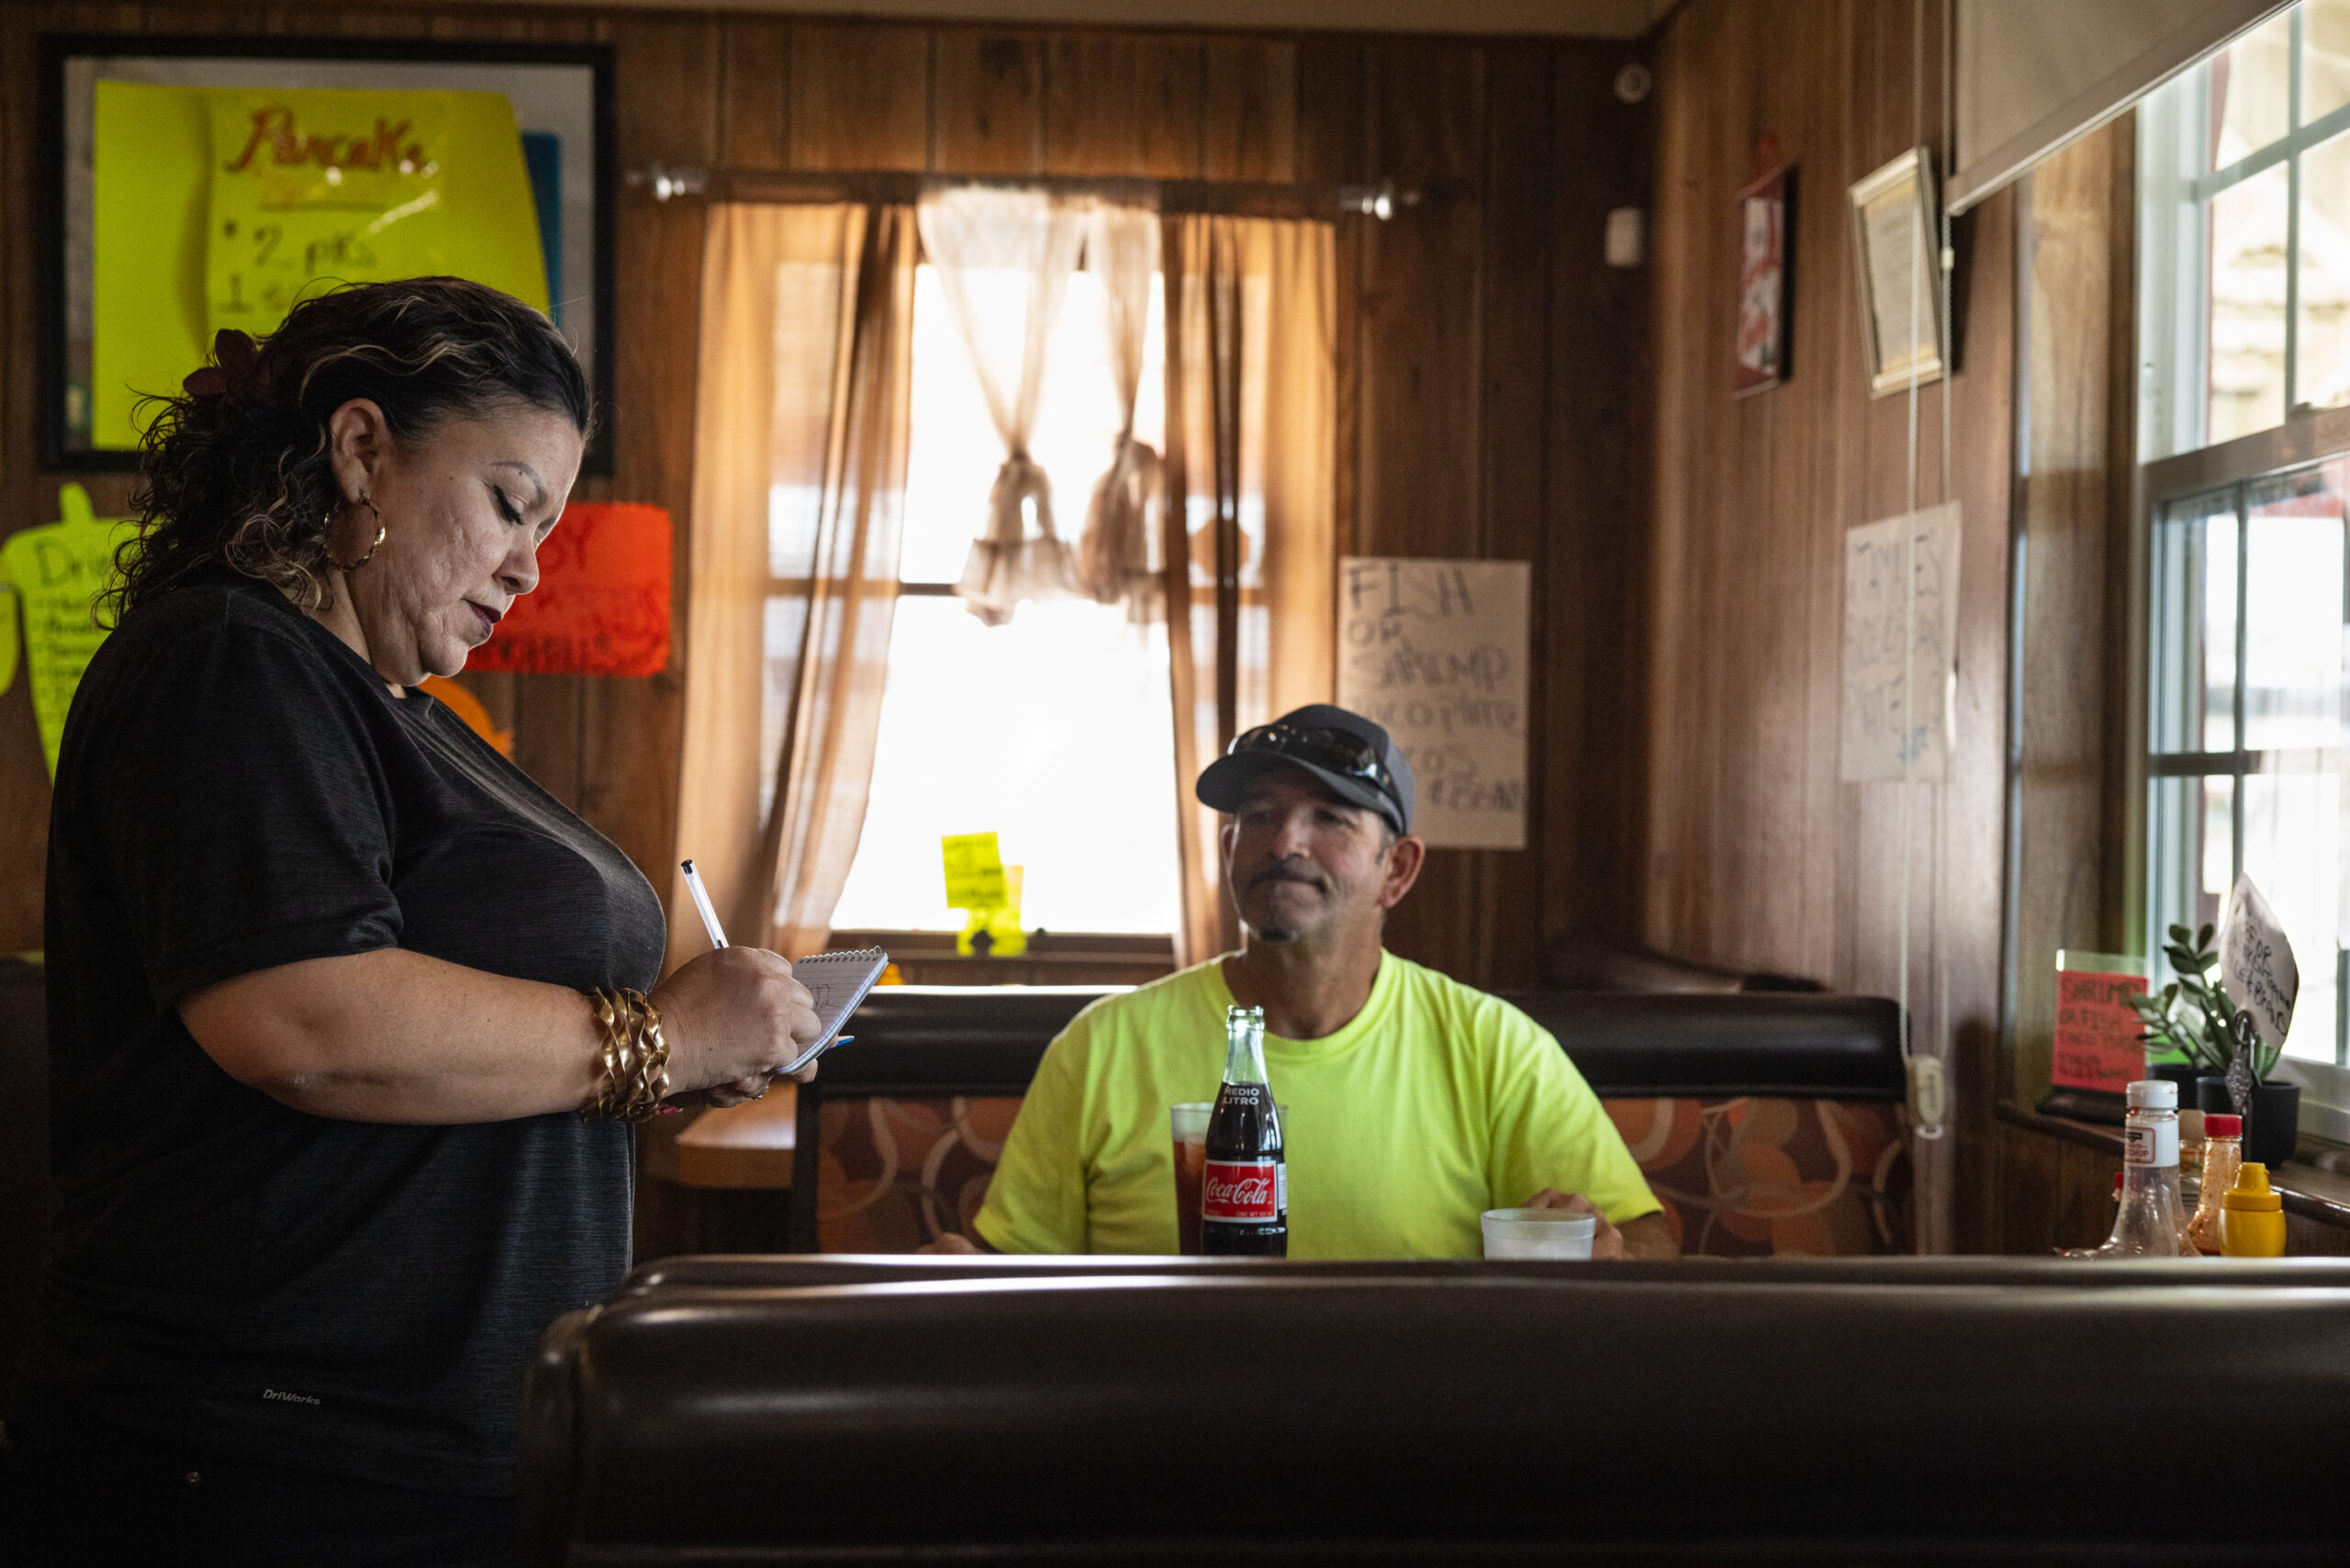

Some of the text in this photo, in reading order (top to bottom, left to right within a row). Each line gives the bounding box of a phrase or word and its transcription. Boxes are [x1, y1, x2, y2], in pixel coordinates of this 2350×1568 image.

[1347, 562, 1474, 623] FISH
[2061, 978, 2142, 1008] SHRIMP
[1222, 1096, 1259, 1105] LITRO
[1224, 1087, 1260, 1096] MEDIO
[1205, 1177, 1270, 1205] Coca-Cola
[263, 1389, 321, 1406] DriWorks
